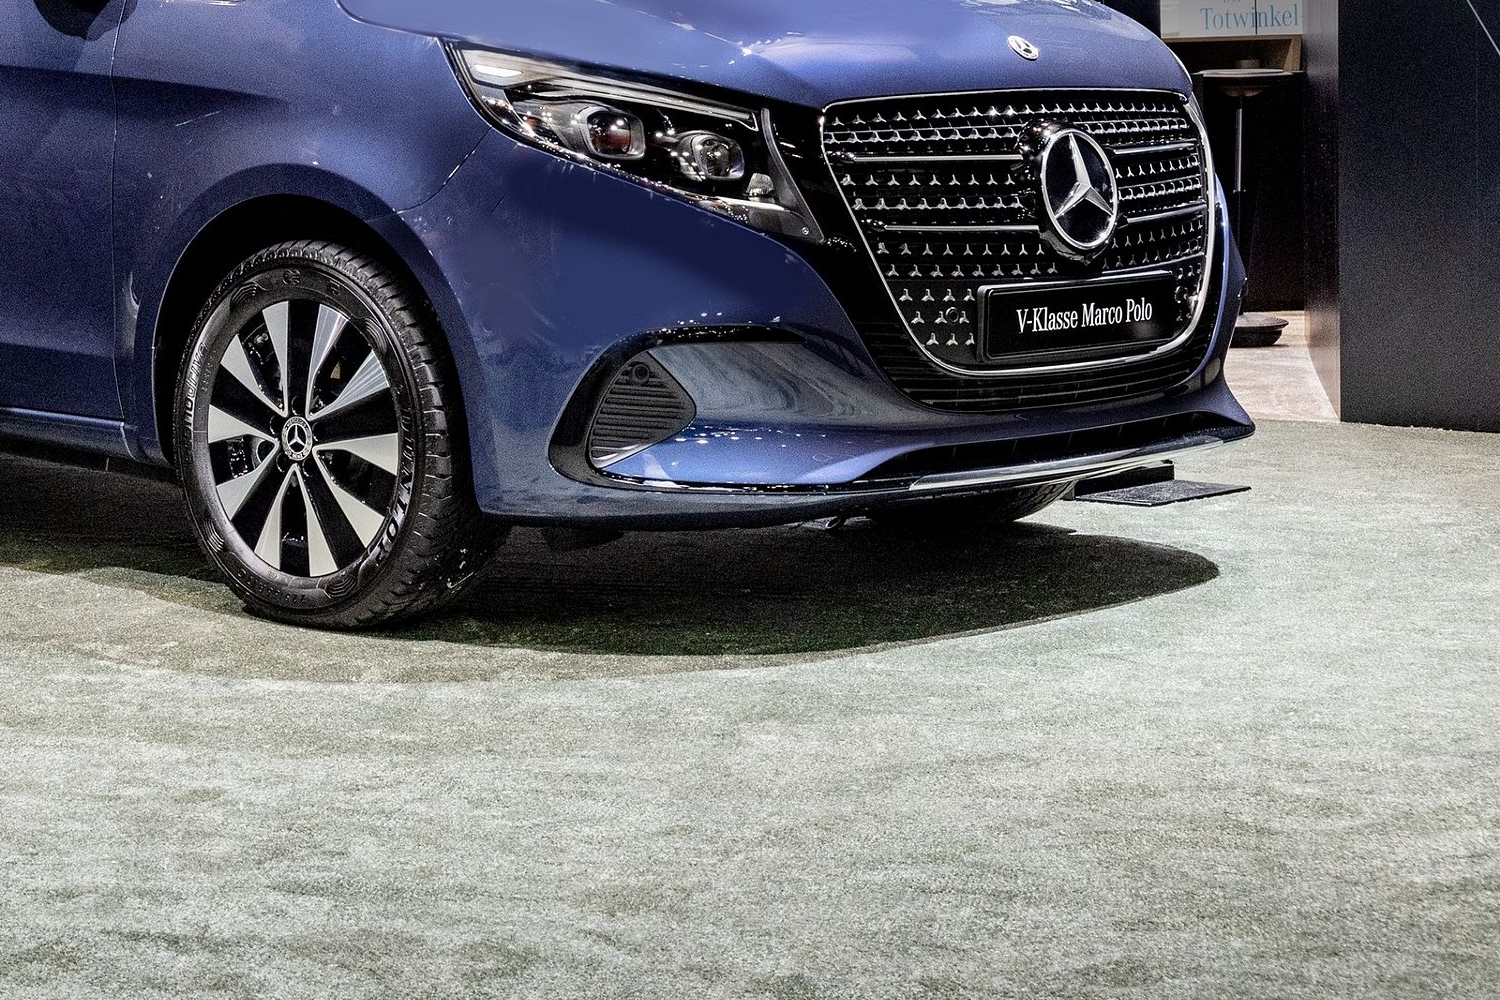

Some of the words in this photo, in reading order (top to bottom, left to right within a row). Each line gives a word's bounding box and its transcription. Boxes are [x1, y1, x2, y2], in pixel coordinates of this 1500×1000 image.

[1016, 306, 1078, 333] V-Klasse
[1081, 302, 1122, 327] Marco
[1125, 297, 1152, 322] Polo
